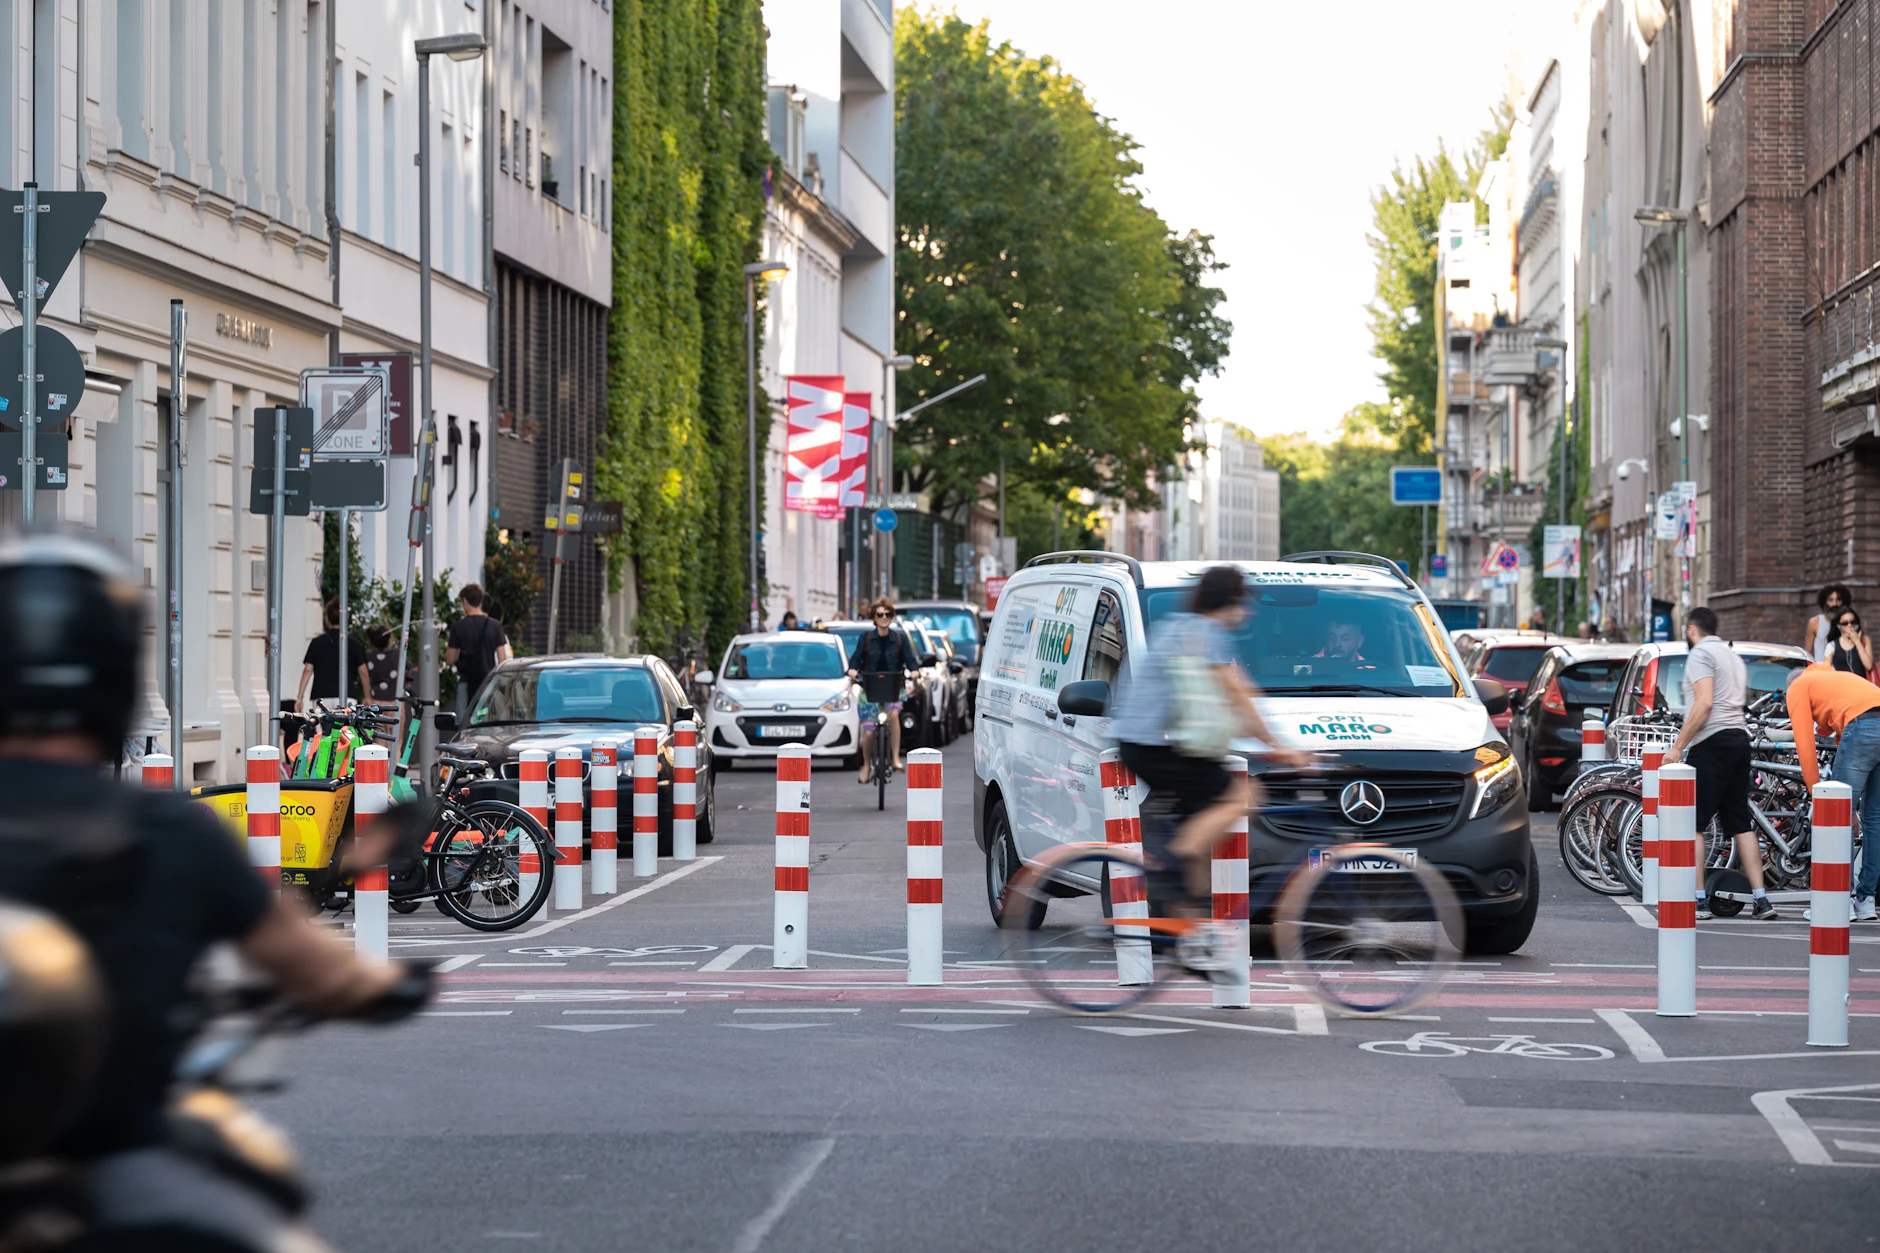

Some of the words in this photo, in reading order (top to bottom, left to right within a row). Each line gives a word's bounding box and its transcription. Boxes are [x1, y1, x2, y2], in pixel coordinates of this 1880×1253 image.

[324, 436, 364, 449] ZONE
[787, 380, 843, 498] KW
[1055, 586, 1078, 616] OPTI
[1036, 619, 1075, 665] MARO
[1040, 667, 1058, 689] GmbH
[1299, 723, 1392, 734] MARO
[1317, 715, 1365, 723] OPTI
